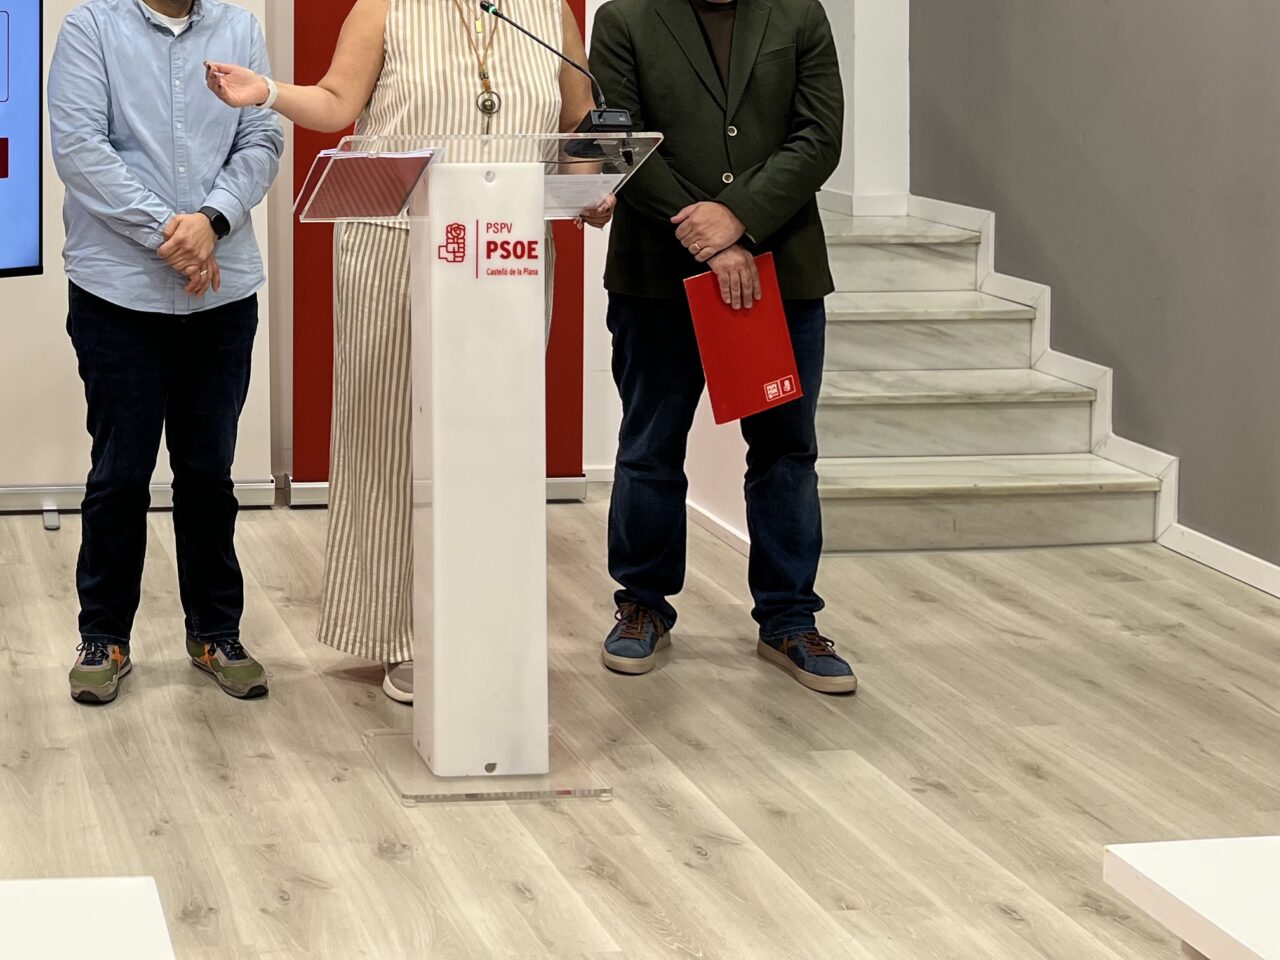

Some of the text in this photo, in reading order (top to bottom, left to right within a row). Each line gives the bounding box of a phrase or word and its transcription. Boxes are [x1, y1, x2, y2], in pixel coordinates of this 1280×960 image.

[486, 222, 513, 234] PSPV
[486, 240, 539, 260] PSOE
[509, 267, 516, 276] de
[523, 267, 539, 276] Plana
